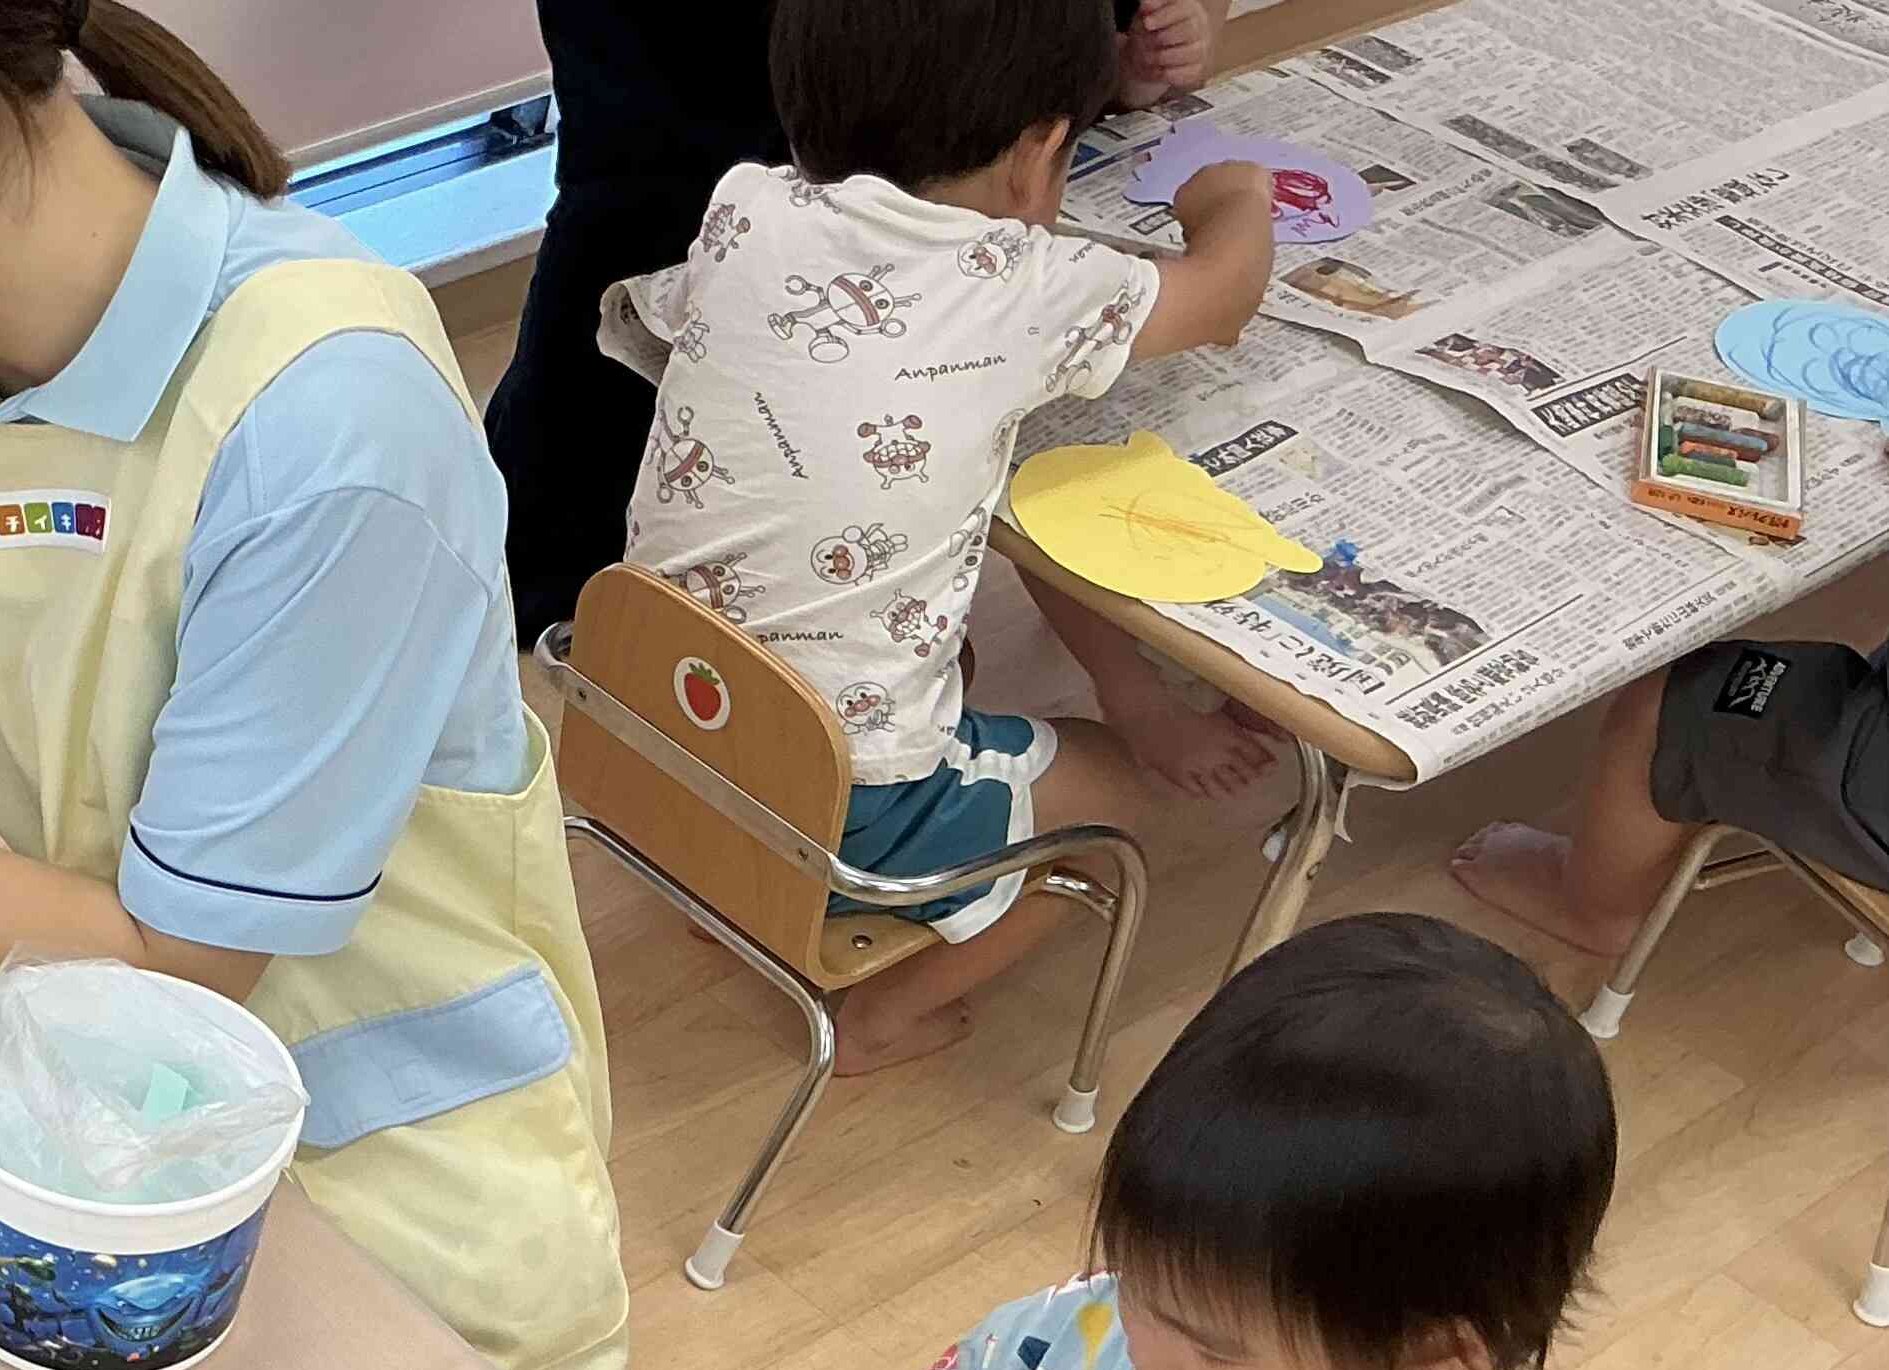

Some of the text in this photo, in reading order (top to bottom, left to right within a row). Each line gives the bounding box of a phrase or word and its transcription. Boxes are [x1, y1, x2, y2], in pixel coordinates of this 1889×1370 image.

[894, 354, 1007, 382] Anpanman
[753, 391, 809, 480] Anpanman
[757, 631, 844, 644] panman
